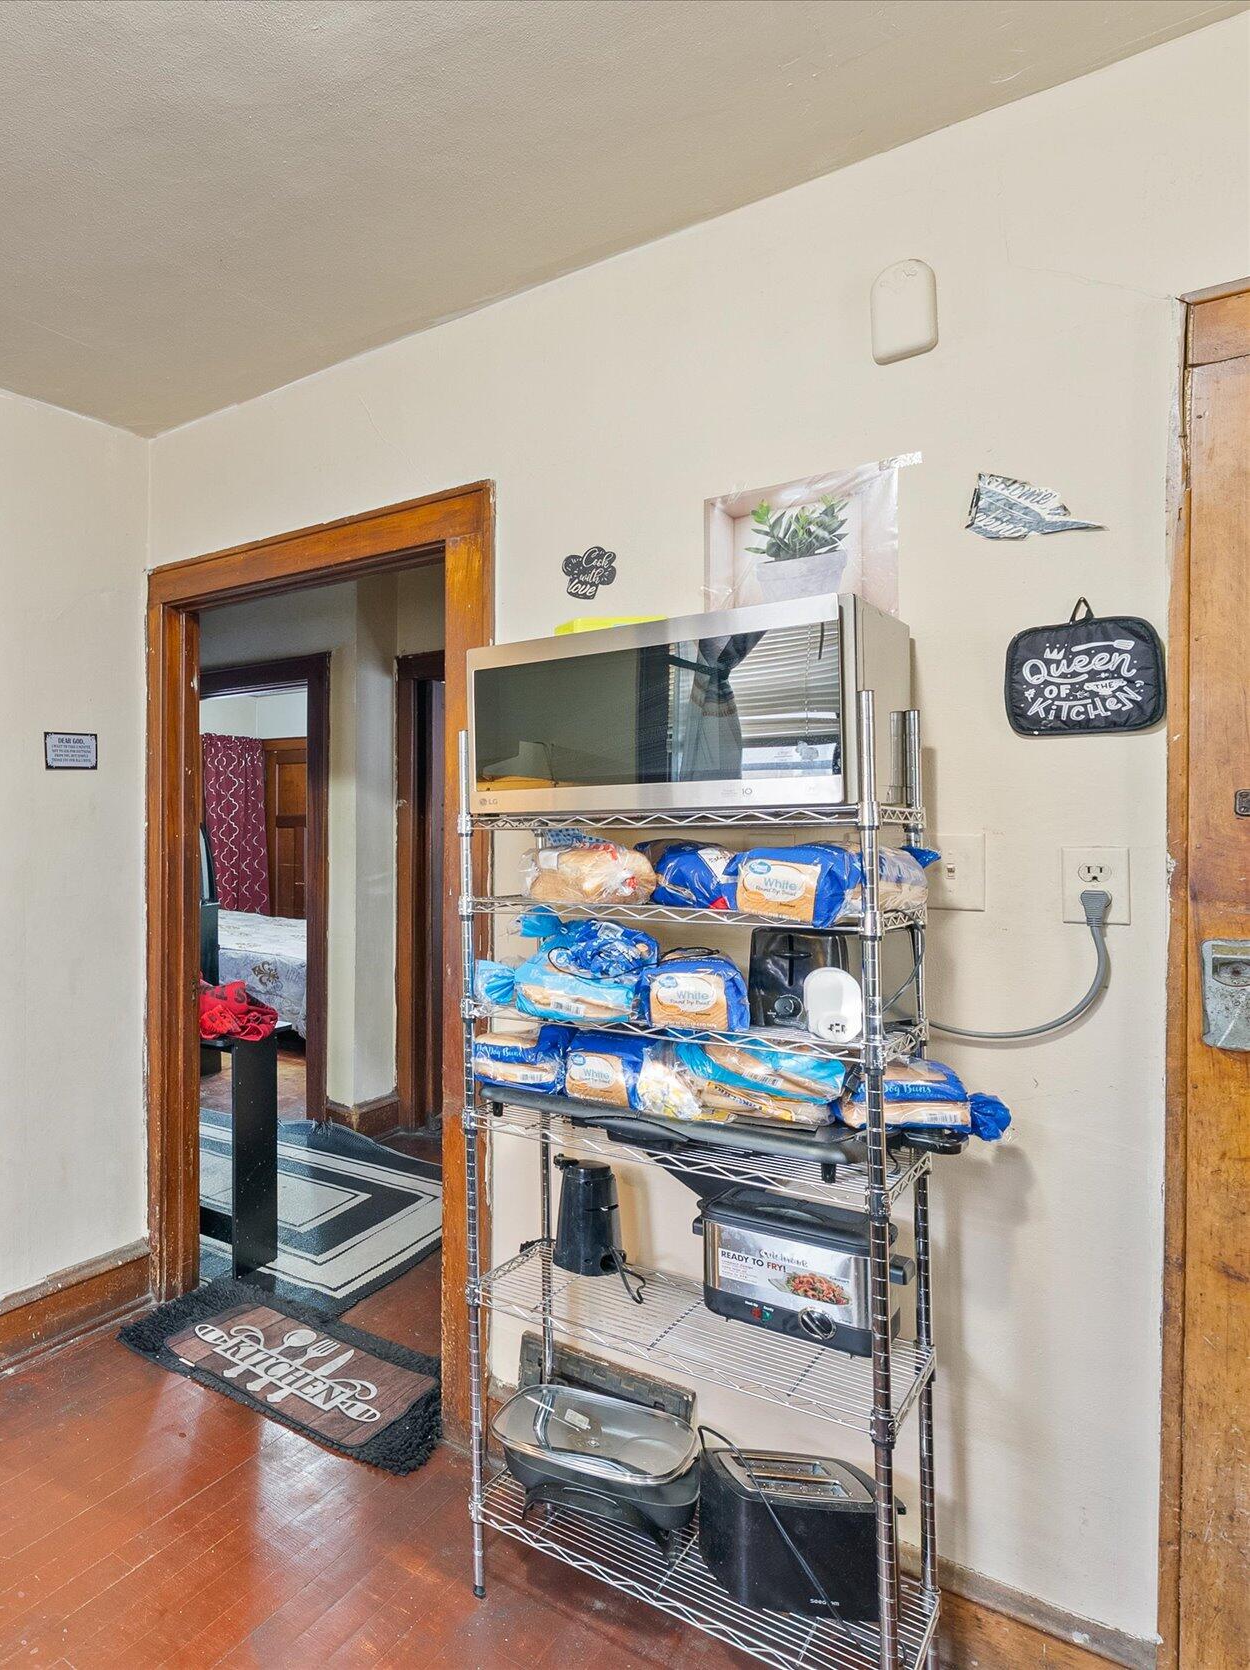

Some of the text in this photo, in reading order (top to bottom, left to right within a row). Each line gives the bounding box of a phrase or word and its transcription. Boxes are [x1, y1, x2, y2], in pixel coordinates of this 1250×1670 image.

[582, 548, 614, 568] Cook
[579, 568, 605, 584] with
[567, 579, 597, 596] love
[1022, 652, 1138, 685] Queen
[1043, 681, 1115, 699] OF THE
[763, 877, 798, 891] White
[676, 990, 710, 1001] White
[903, 1083, 932, 1093] Buns
[720, 1249, 750, 1265] READY
[751, 1256, 765, 1267] TO
[766, 1261, 787, 1273] FRY!
[226, 1338, 347, 1406] KITCHEN
